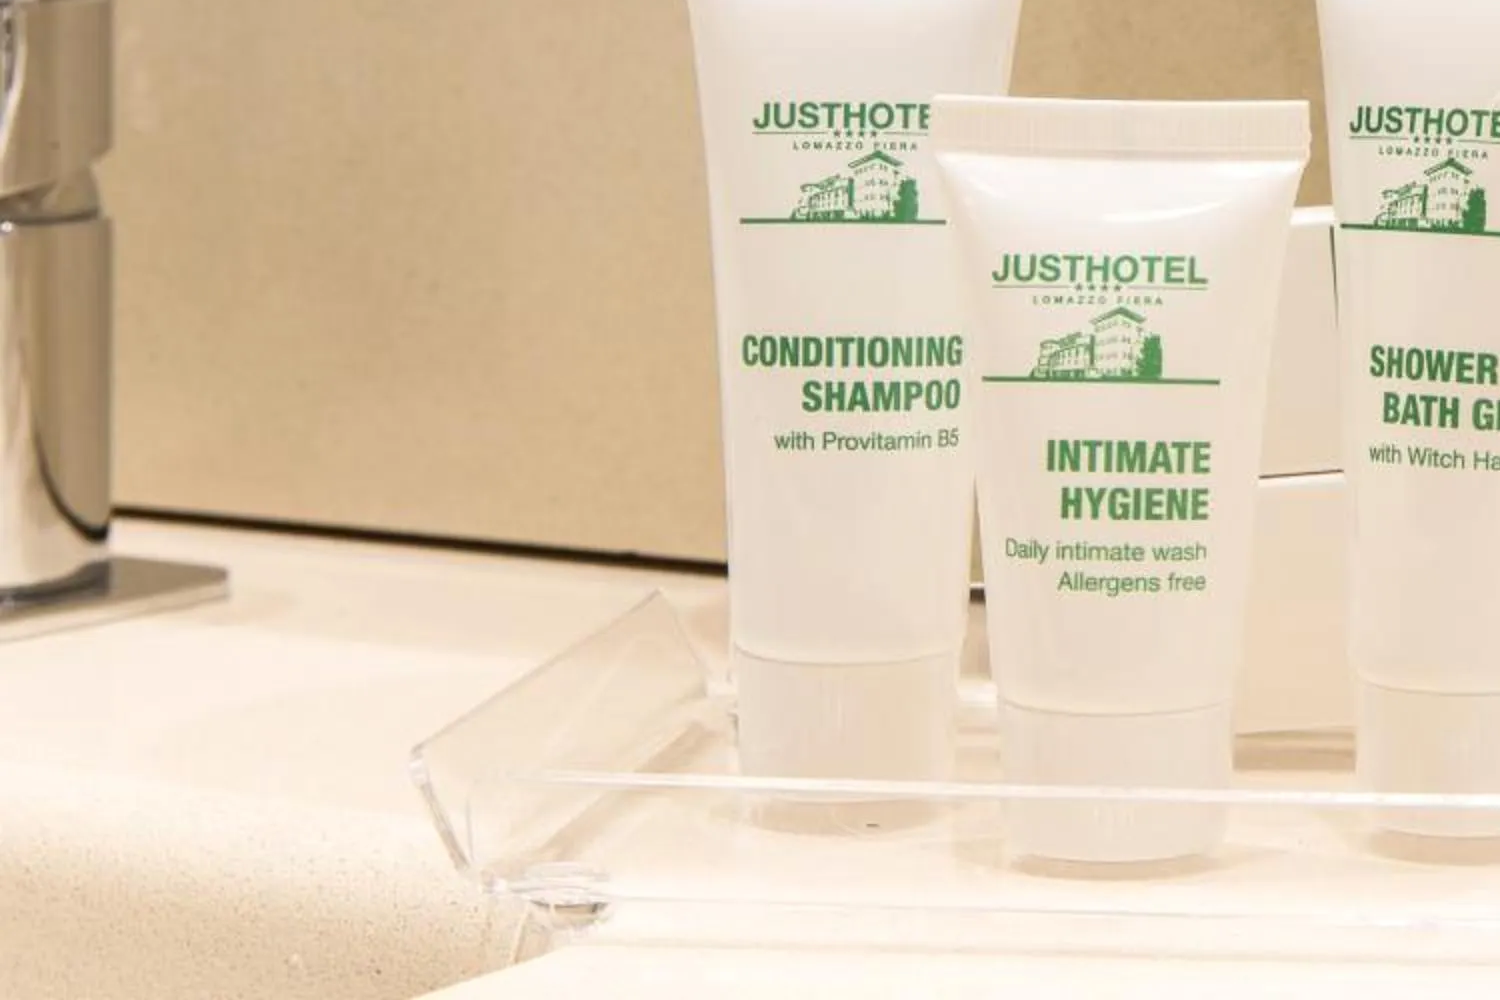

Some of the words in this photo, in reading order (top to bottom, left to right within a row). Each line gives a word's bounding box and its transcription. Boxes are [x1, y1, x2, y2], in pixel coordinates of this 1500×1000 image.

[753, 101, 929, 129] JUSTHOTE
[792, 140, 864, 151] LOMAZZO
[1378, 146, 1440, 157] LOMAZZO
[991, 253, 1209, 284] JUSTHOTEL
[1032, 295, 1107, 306] LOMAZZO
[742, 334, 963, 368] CONDITIONING
[1369, 344, 1499, 386] SHOWER
[801, 378, 961, 413] SHAMPOO
[1382, 391, 1461, 429] BATH
[773, 430, 815, 451] with
[821, 430, 932, 452] Provitamin
[937, 427, 960, 448] B5
[1046, 439, 1211, 474] INTIMATE
[1368, 443, 1402, 464] with
[1407, 445, 1466, 470] Witch
[1060, 486, 1209, 521] HYGIENE
[1005, 537, 1051, 565] Daily
[1055, 541, 1146, 562] intimate
[1151, 542, 1207, 562] wash
[1057, 570, 1161, 597] Allergens
[1166, 571, 1207, 592] free
